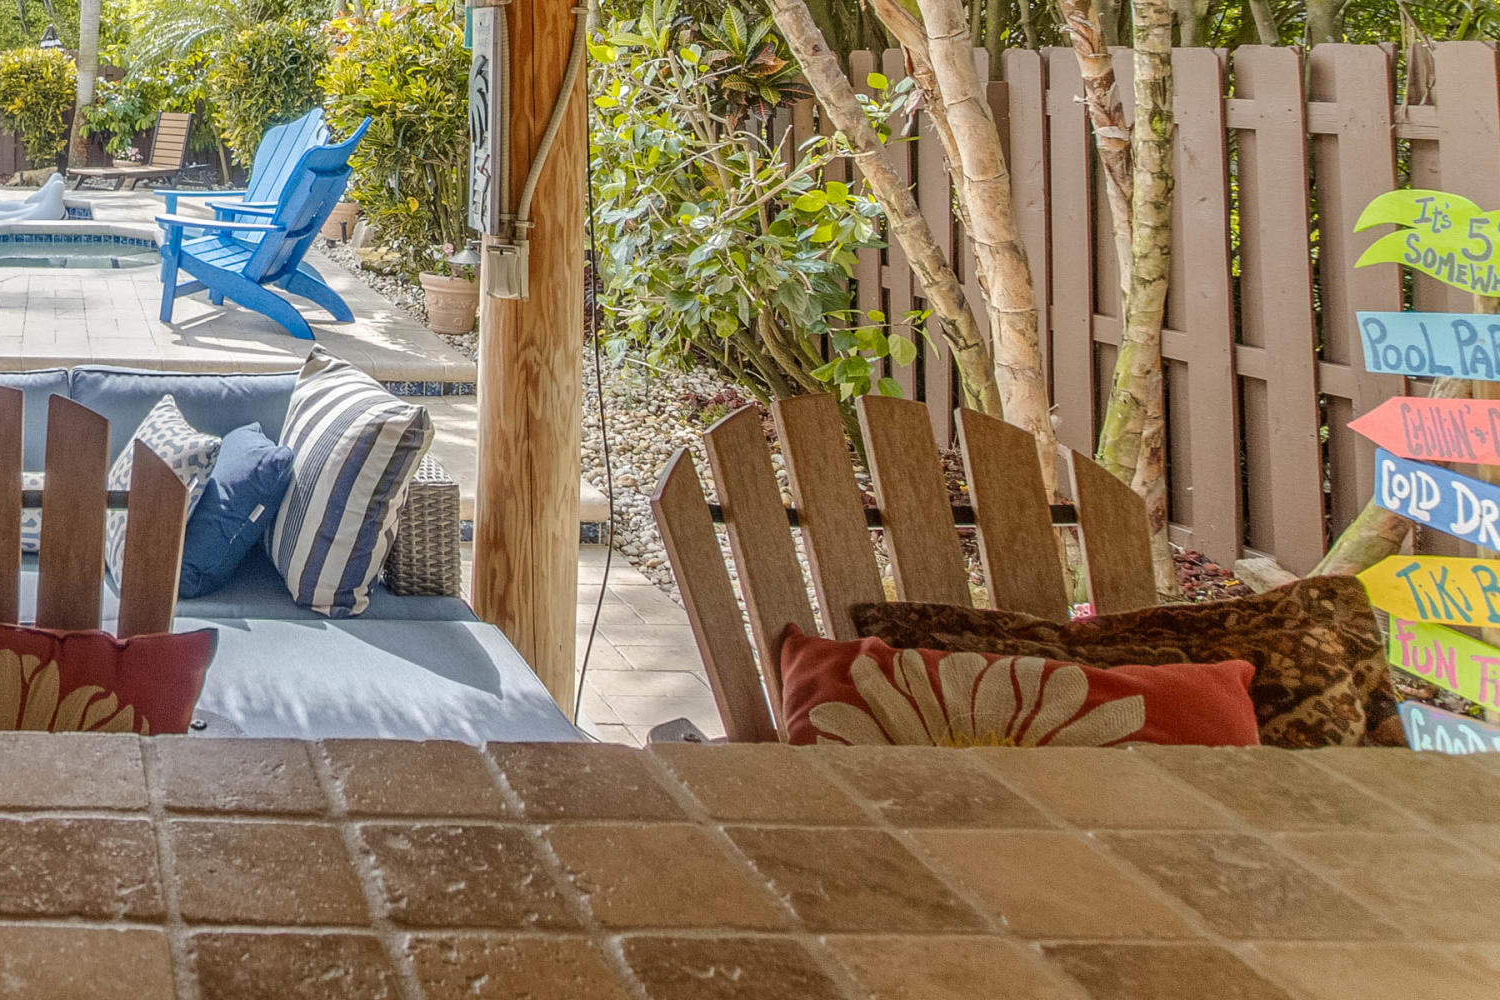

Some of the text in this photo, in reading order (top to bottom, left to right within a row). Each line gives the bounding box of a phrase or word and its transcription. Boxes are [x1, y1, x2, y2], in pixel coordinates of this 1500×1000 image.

[1412, 197, 1493, 262] It's 5
[1381, 459, 1440, 522] COLD
